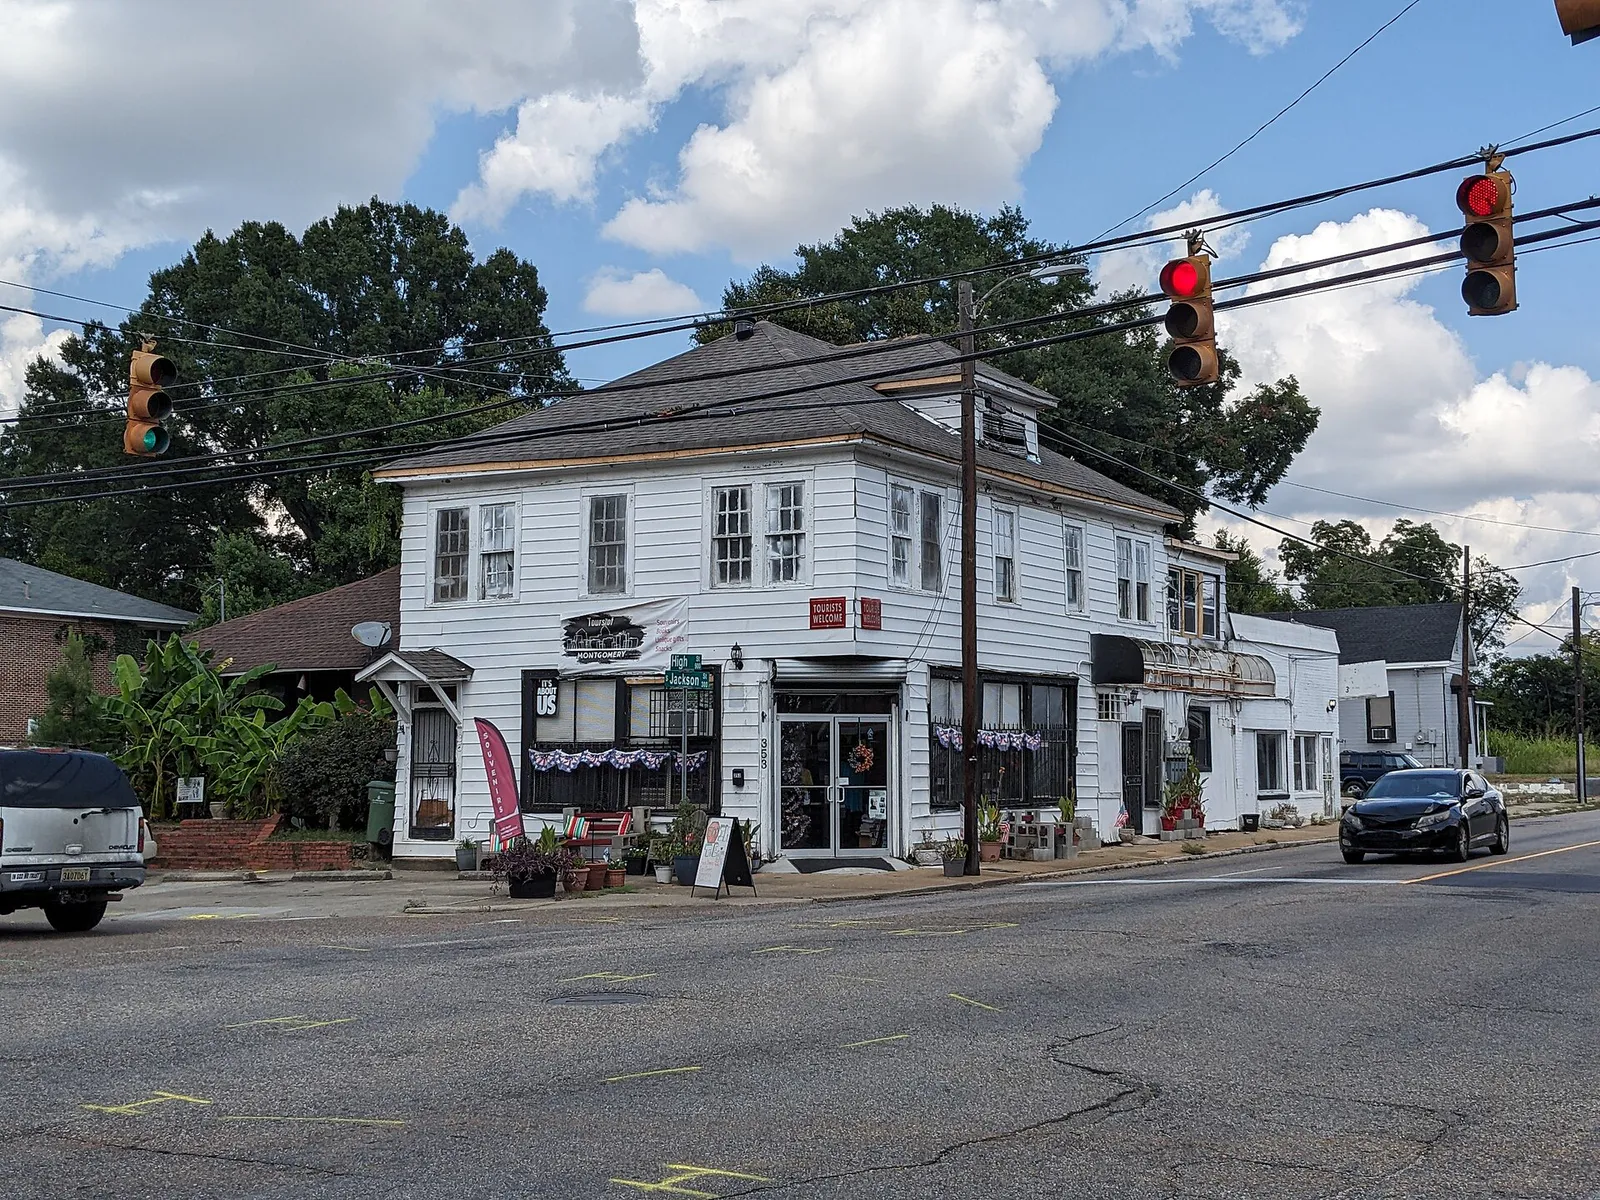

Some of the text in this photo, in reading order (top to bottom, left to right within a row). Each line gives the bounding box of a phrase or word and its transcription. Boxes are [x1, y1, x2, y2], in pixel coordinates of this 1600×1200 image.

[813, 603, 843, 613] TOURISTS
[813, 614, 843, 624] WELCOME
[577, 650, 627, 659] MONTGOMERY
[671, 655, 688, 670] High
[669, 672, 700, 686] Jackson
[537, 687, 557, 695] ABOUT
[536, 695, 557, 716] US
[483, 732, 504, 815] SOUVENIRS
